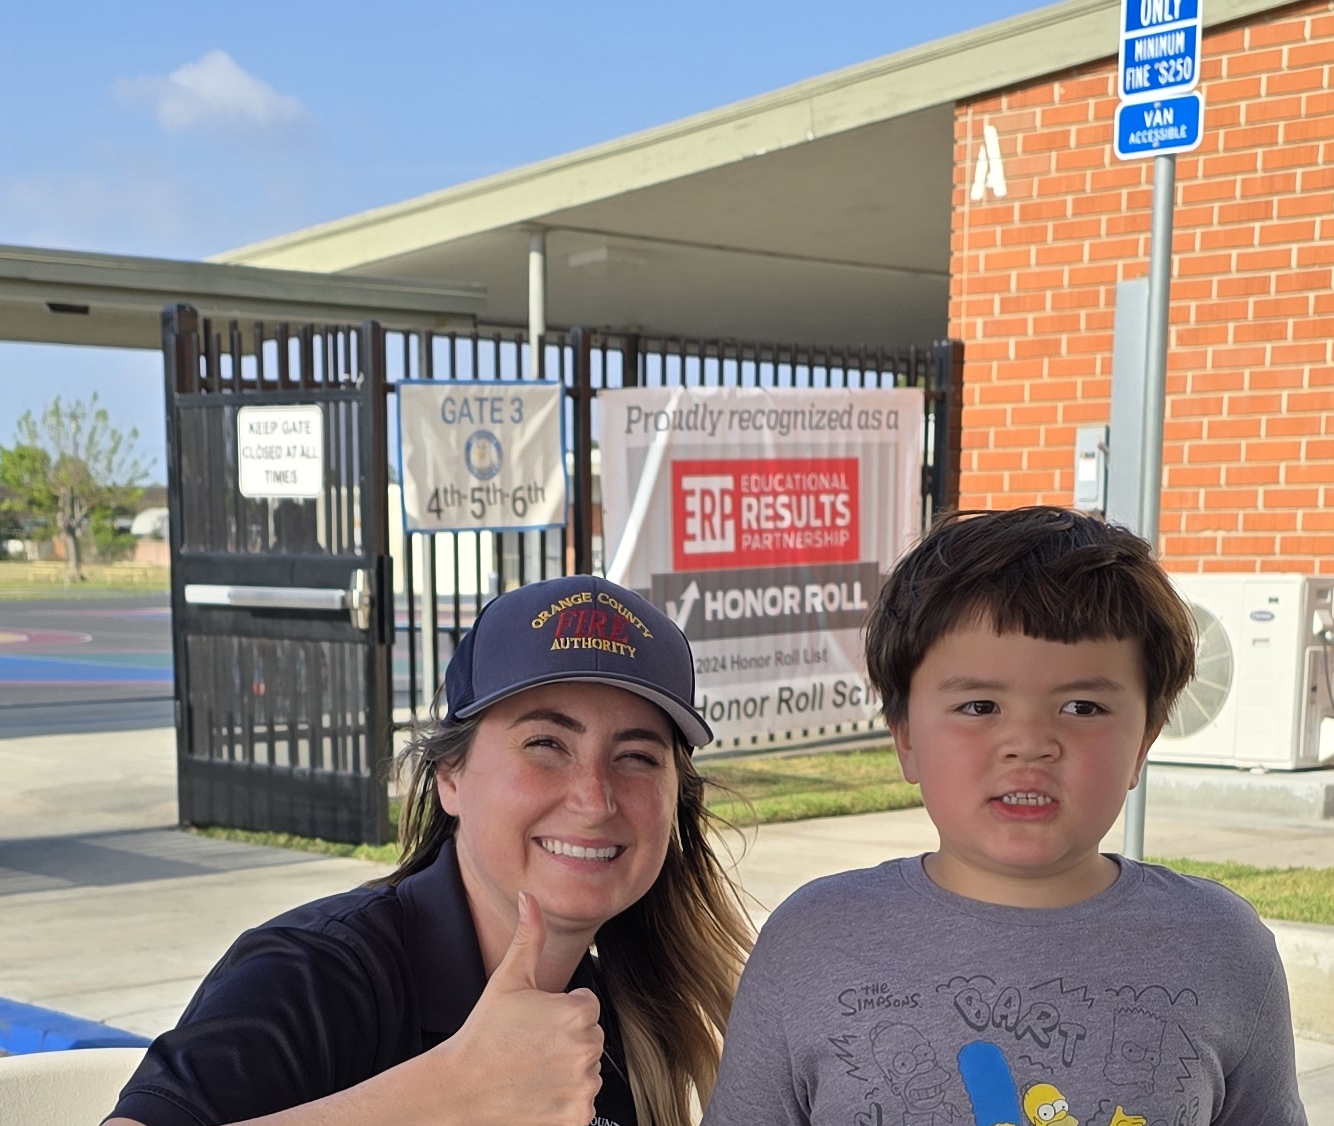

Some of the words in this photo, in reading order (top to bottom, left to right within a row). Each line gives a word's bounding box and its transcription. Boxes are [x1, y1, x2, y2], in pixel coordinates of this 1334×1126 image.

[1134, 30, 1185, 62] MINIMUM
[1126, 66, 1150, 90] FINE
[1156, 56, 1192, 85] $250
[1144, 107, 1173, 128] VAN
[1129, 124, 1187, 145] ACCESSIBLE
[970, 125, 1007, 200] A
[441, 397, 504, 424] GATE
[510, 397, 524, 424] 3
[625, 402, 723, 437] Proudly
[728, 402, 854, 436] recognized
[857, 408, 882, 431] as
[885, 408, 899, 431] a
[248, 421, 278, 435] KEEP
[281, 420, 312, 435] GATE
[242, 444, 283, 460] CLOSED
[264, 469, 298, 484] TIMES
[740, 472, 850, 493] EDUCATIONAL
[740, 494, 852, 530] RESULTS
[741, 530, 850, 551] PARTNERSHIP
[704, 584, 801, 621] HONOR
[805, 580, 869, 614] ROLL
[531, 592, 593, 630] ORANGE
[598, 593, 654, 640] COUNTY
[554, 608, 630, 645] FIRE
[550, 636, 637, 659] AUTHORITY
[695, 657, 727, 675] 2024
[730, 653, 771, 671] Honor
[774, 650, 800, 668] Roll
[803, 647, 828, 665] List
[777, 682, 825, 715] Roll
[832, 676, 879, 709] Sch
[954, 986, 1087, 1068] BART
